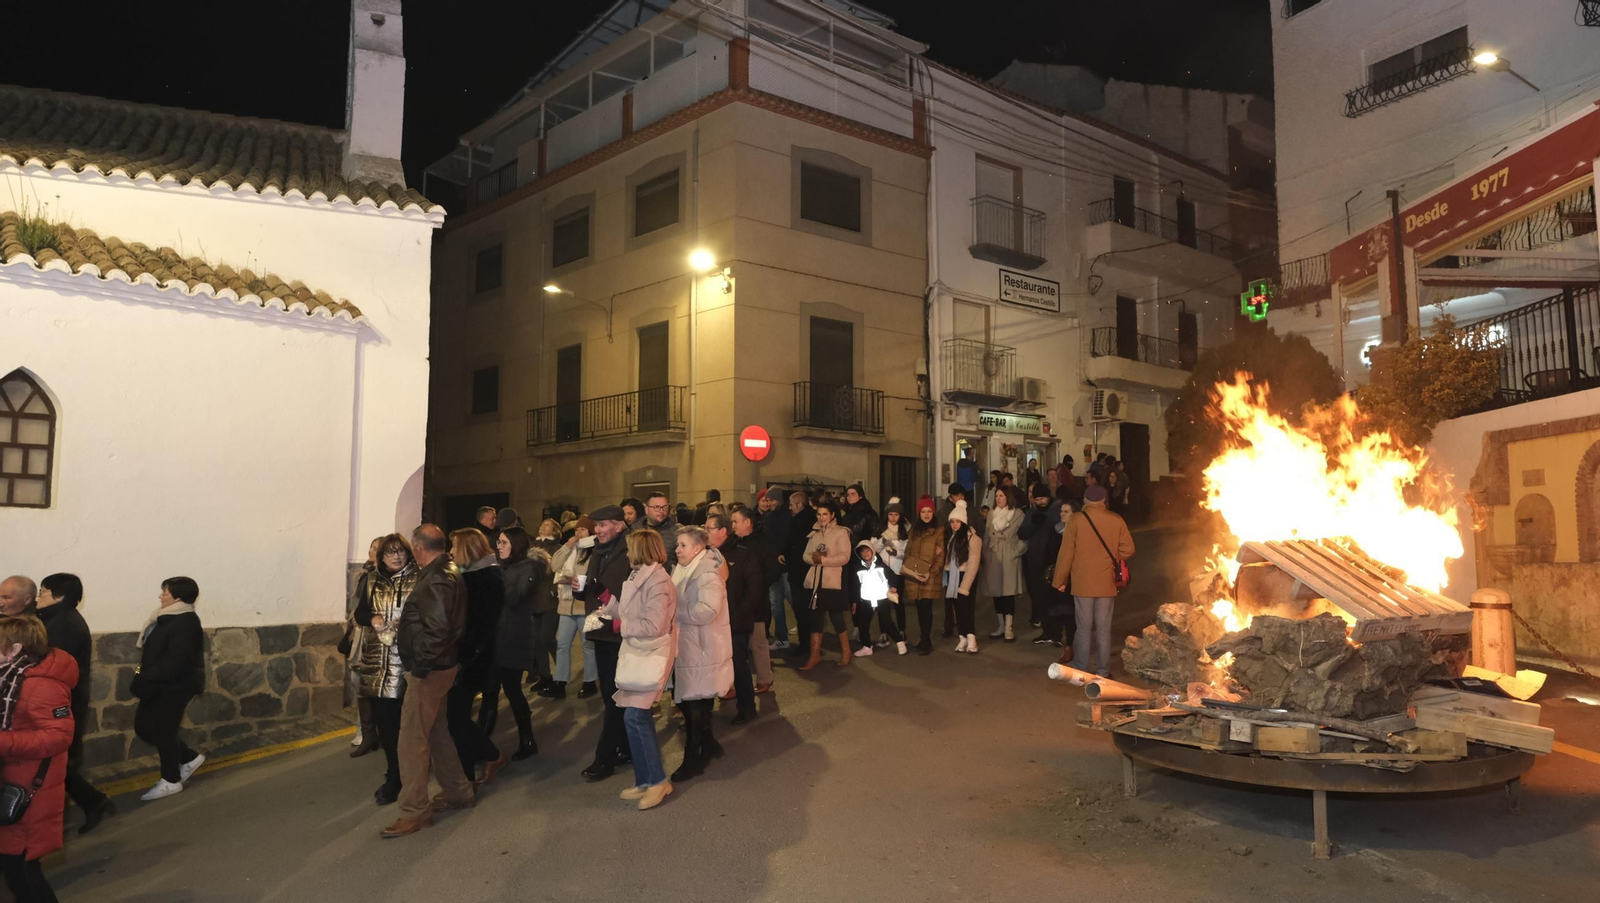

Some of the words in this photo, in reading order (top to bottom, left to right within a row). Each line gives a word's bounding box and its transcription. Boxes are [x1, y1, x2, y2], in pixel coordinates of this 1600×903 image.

[1405, 202, 1449, 233] Desde
[1471, 167, 1509, 201] 1977
[1004, 274, 1056, 297] Restaurante
[1014, 419, 1040, 431] Castillo
